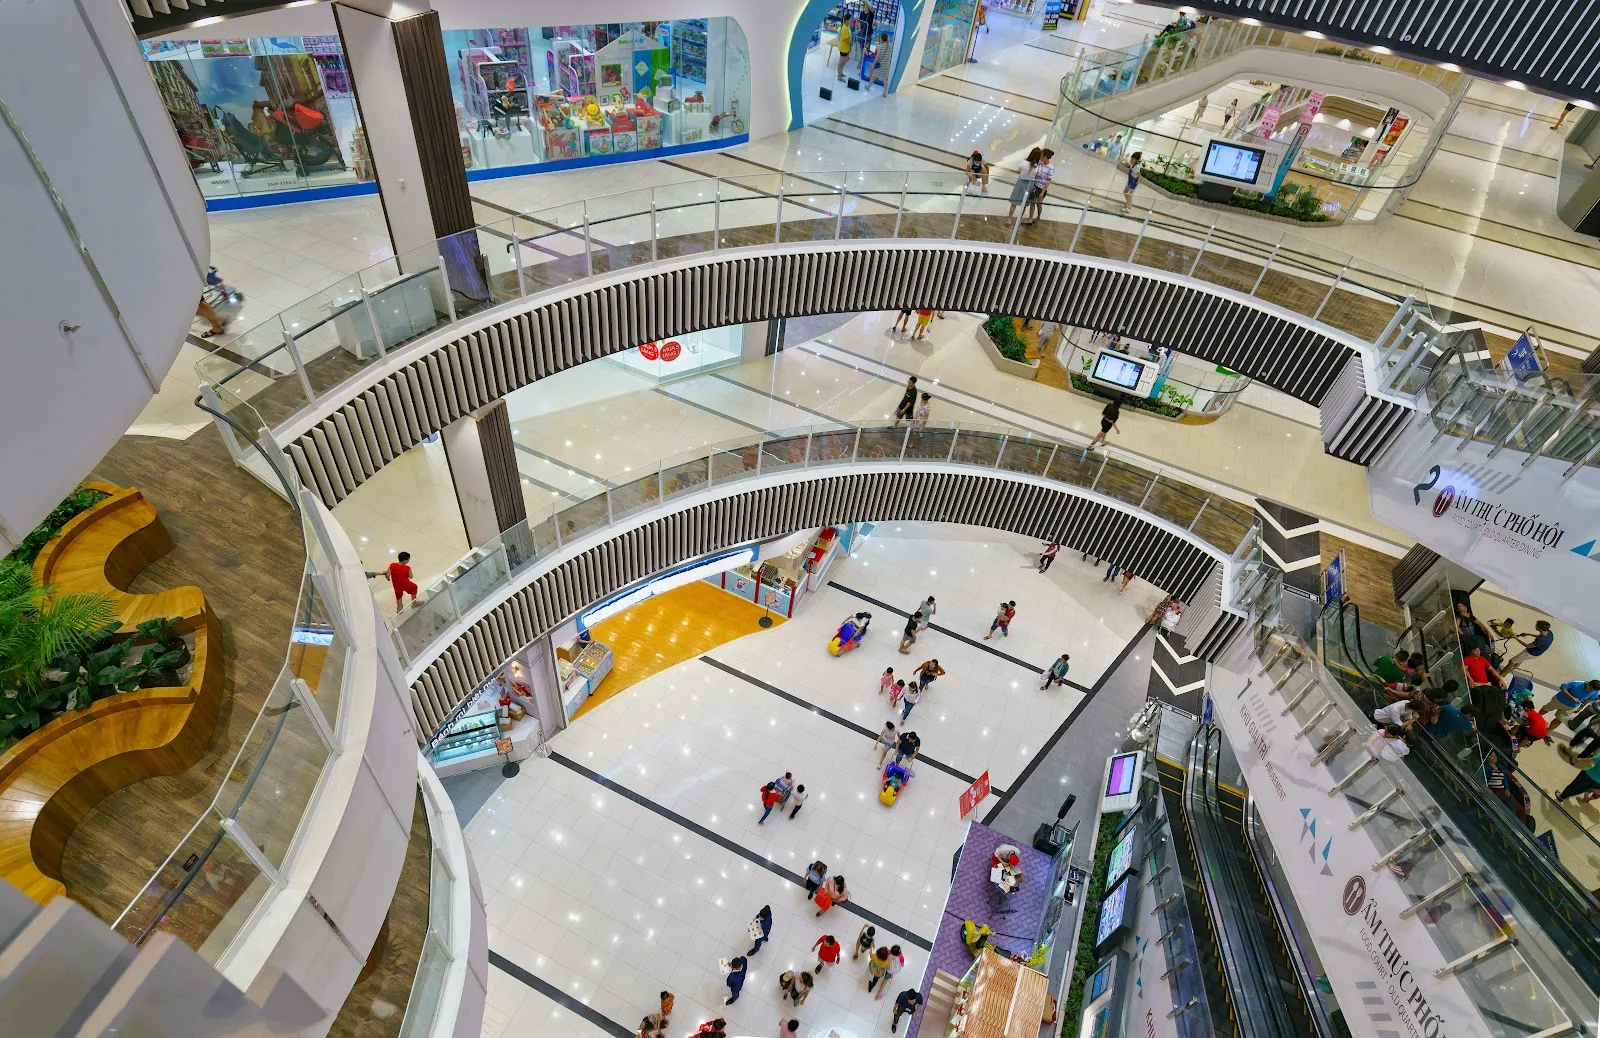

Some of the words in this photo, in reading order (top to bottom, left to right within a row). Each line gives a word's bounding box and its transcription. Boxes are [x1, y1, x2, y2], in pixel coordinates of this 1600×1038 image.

[1413, 464, 1441, 506] 2
[1470, 499, 1507, 527] THỰC
[1502, 510, 1541, 538] PHỐ
[1531, 521, 1566, 550] HỘI
[1240, 703, 1252, 727] KHU
[1256, 737, 1271, 761] TRÍ
[1265, 761, 1287, 802] AMUSEMENT
[1359, 927, 1373, 953] FOOD
[1370, 951, 1388, 980] COURT
[1388, 984, 1400, 1006] OLD
[1361, 898, 1383, 936] ẨM
[1378, 928, 1414, 993] THỰC
